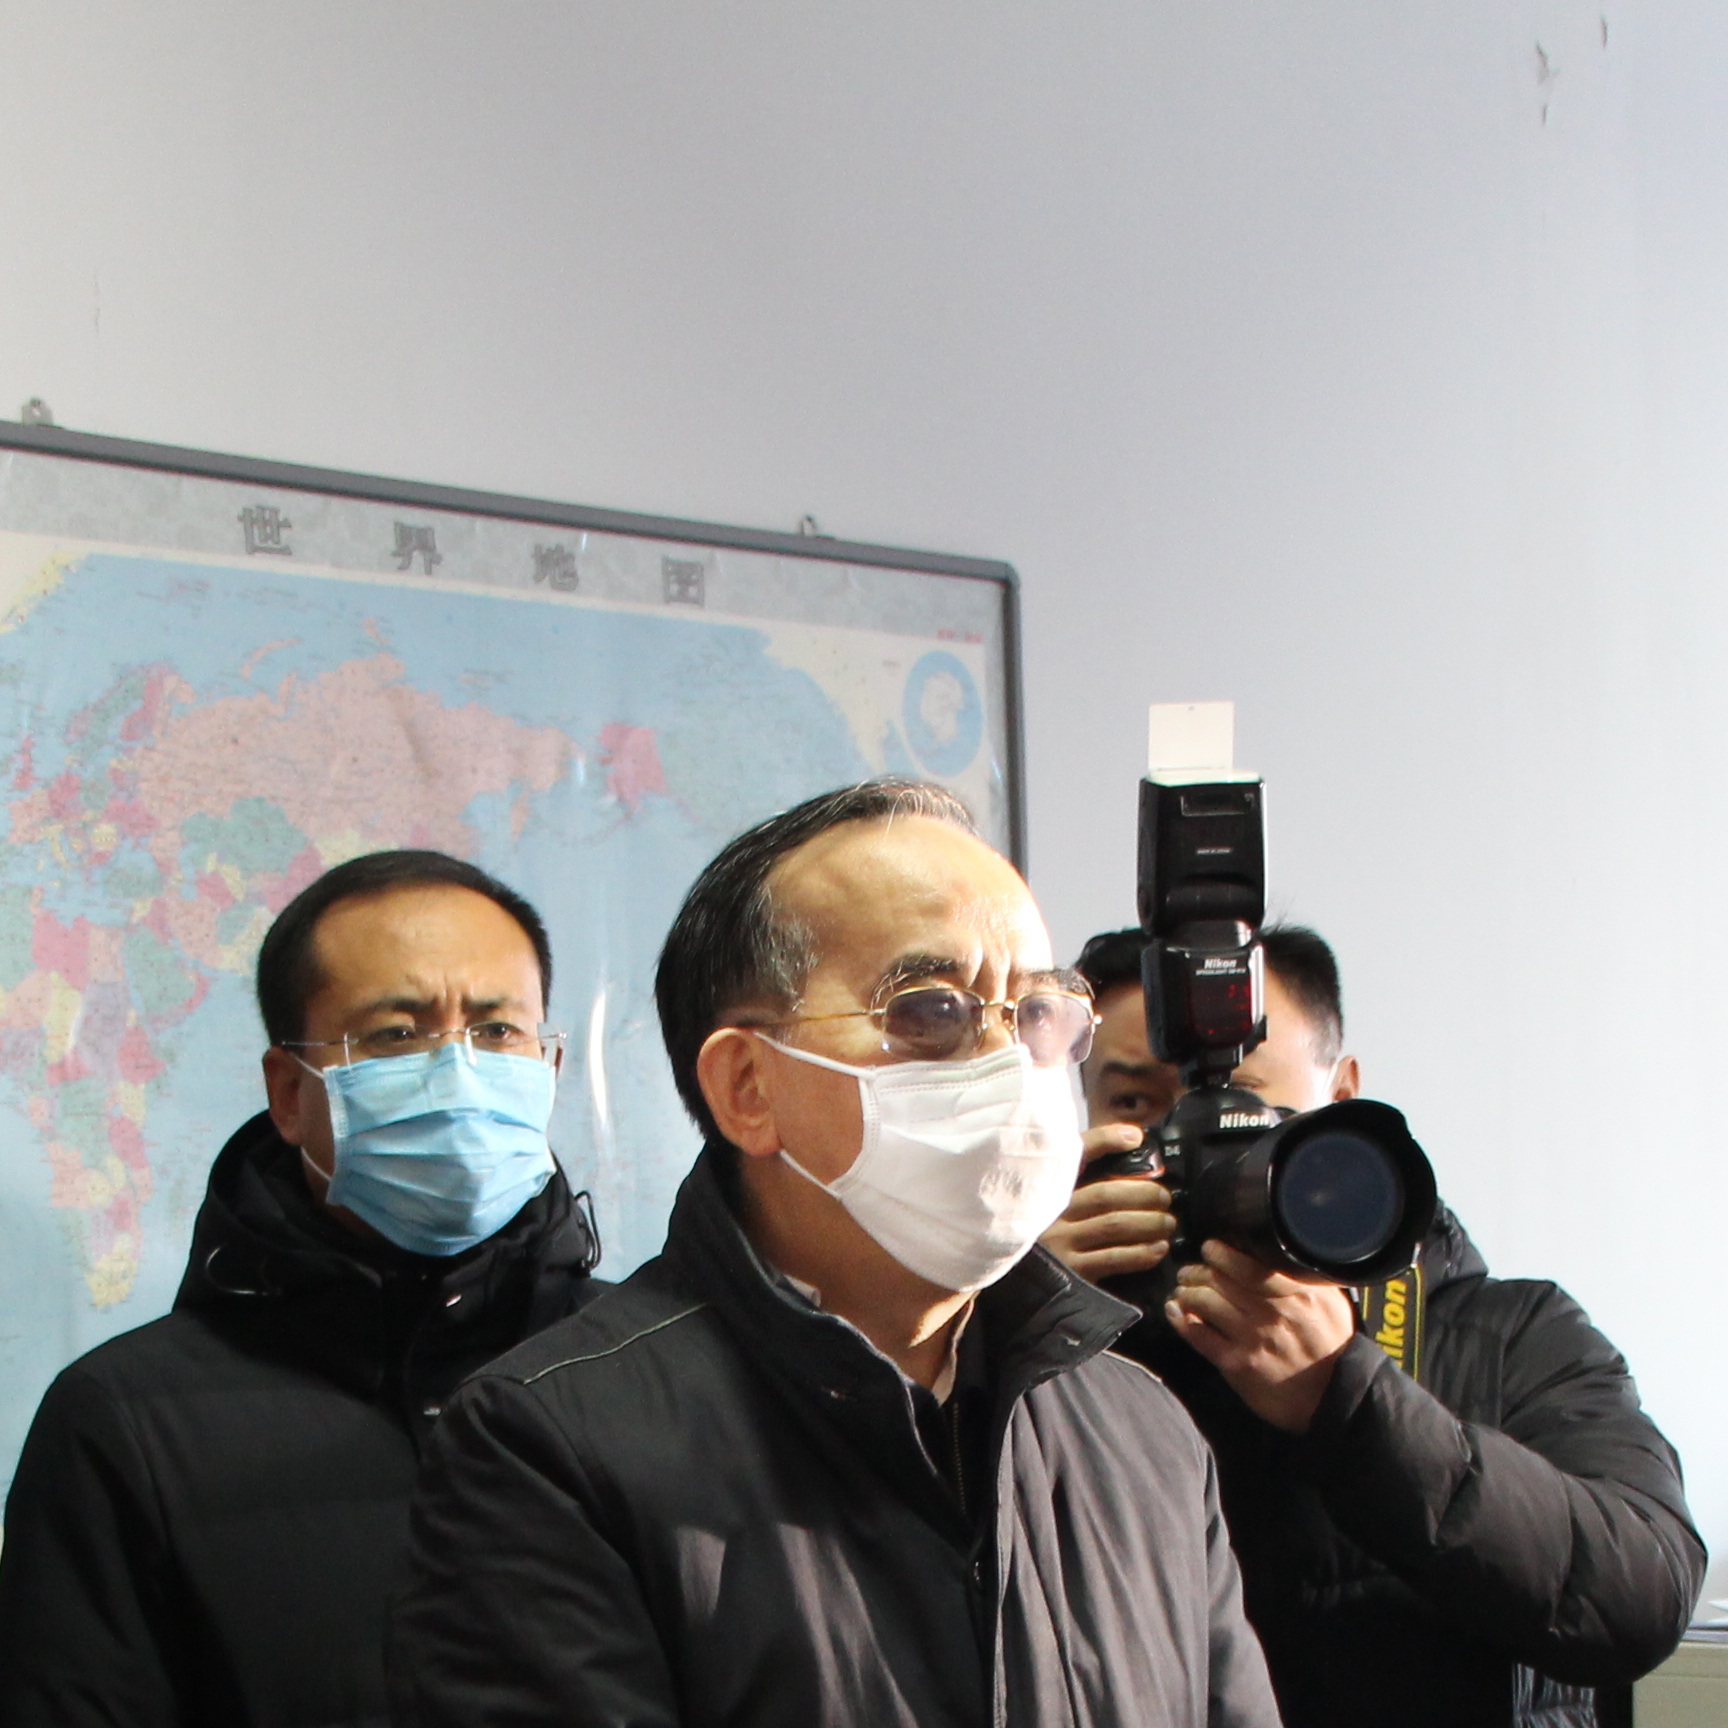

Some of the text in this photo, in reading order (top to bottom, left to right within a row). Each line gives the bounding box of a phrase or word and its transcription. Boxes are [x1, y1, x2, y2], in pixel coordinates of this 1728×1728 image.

[237, 503, 706, 606] 世界地图
[1203, 957, 1238, 970] Nikon
[1218, 1111, 1270, 1129] Nikon
[1375, 1278, 1408, 1370] ikon
